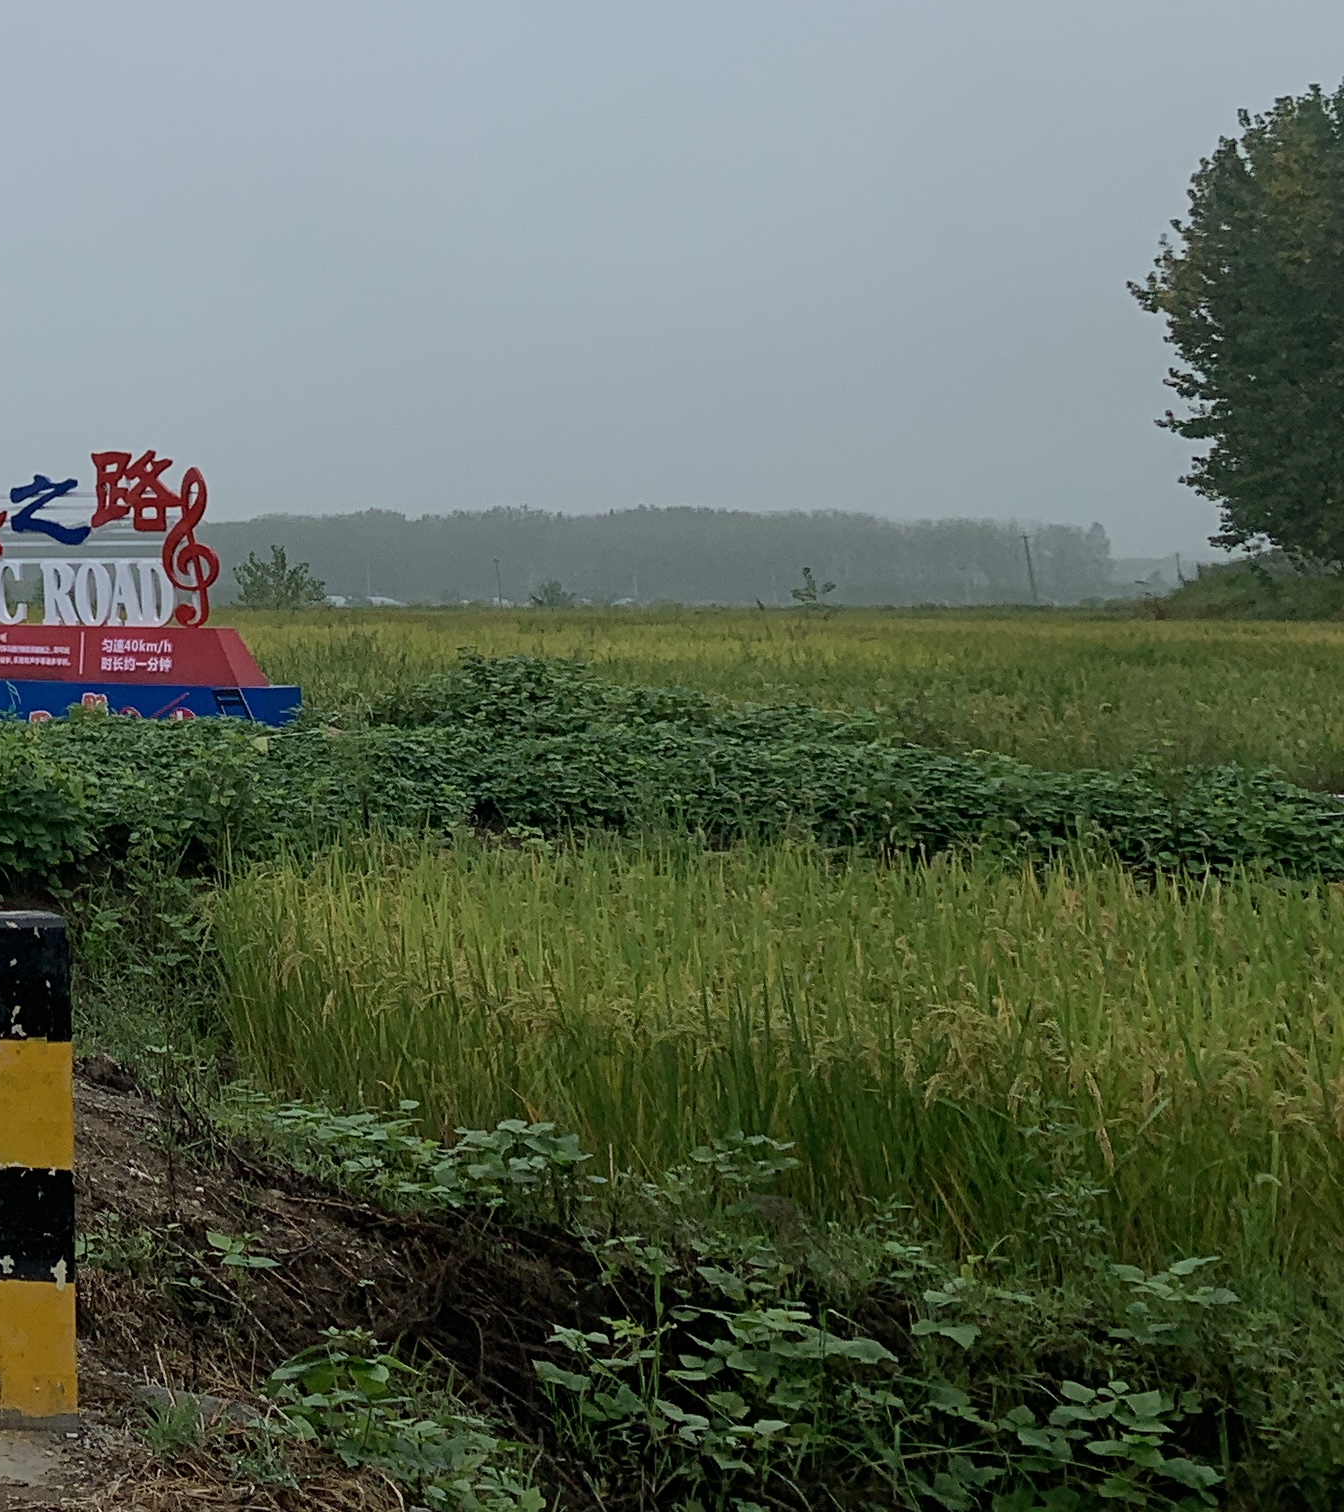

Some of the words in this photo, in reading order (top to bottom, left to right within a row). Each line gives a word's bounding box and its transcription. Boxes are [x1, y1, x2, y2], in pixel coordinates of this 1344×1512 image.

[40, 561, 177, 628] ROAD
[100, 656, 173, 673] 时长约一分钟
